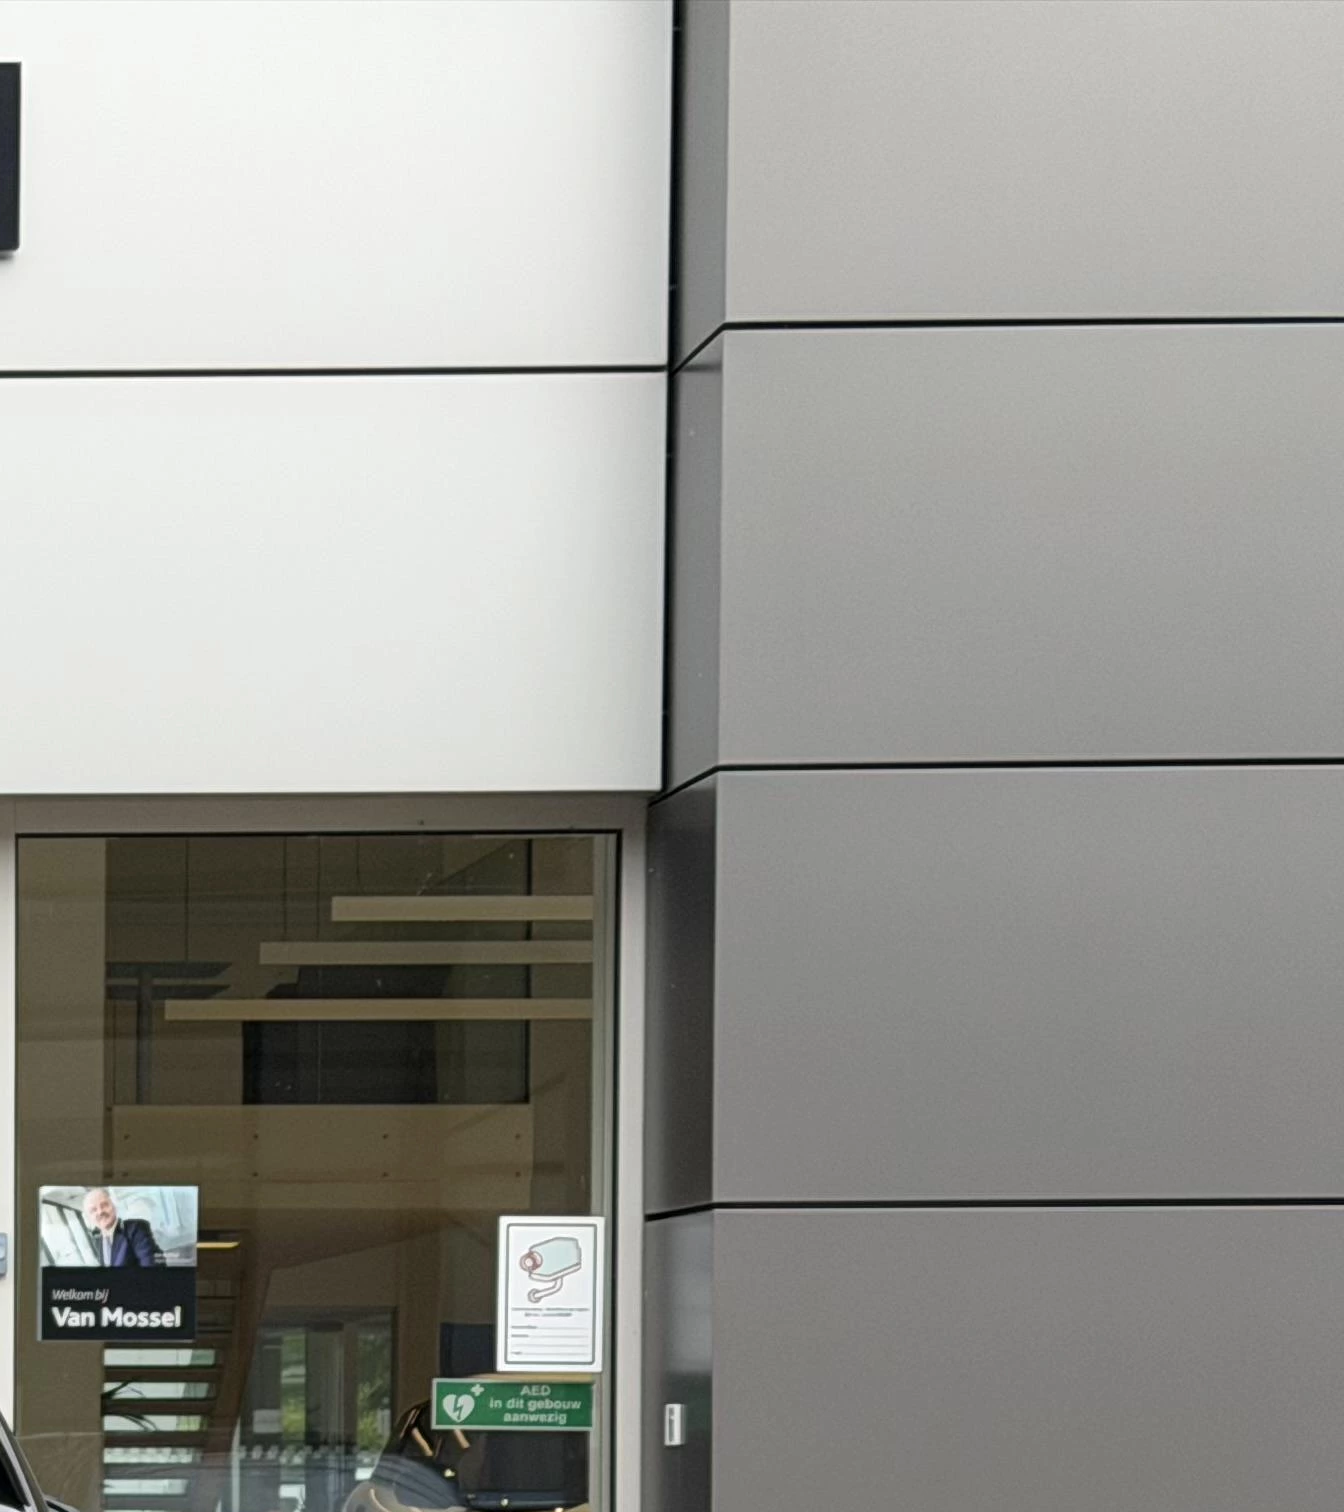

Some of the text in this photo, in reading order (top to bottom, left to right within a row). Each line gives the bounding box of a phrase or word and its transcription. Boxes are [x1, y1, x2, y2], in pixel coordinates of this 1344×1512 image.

[52, 1289, 109, 1303] Welkom bij
[51, 1306, 182, 1327] Van Mossel
[520, 1385, 551, 1396] AED
[506, 1398, 524, 1409] dit
[527, 1398, 582, 1411] gebouw
[503, 1411, 567, 1425] aanwezig
